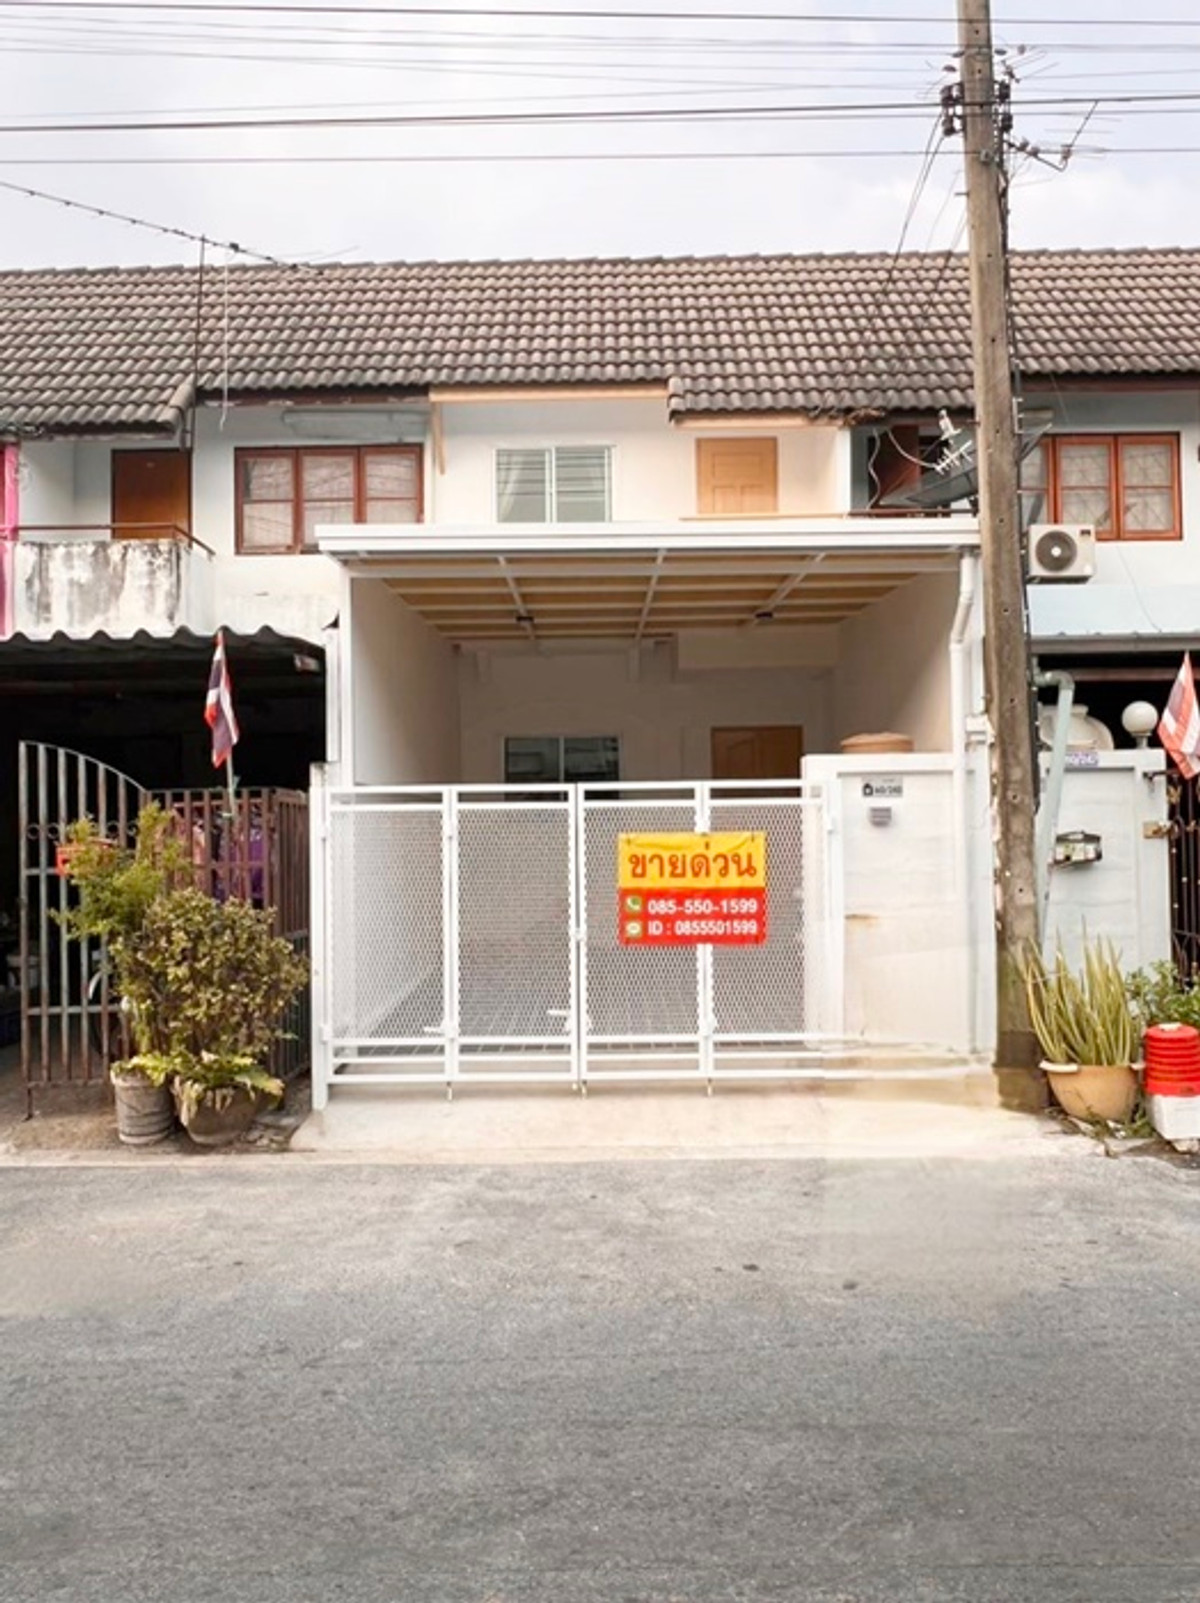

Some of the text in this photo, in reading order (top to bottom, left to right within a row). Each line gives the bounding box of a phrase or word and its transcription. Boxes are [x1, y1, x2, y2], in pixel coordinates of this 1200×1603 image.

[628, 841, 758, 879] ขายด่วน
[647, 898, 758, 915] 085-550-1599
[647, 920, 664, 936] ID
[674, 920, 758, 936] 0855501599
